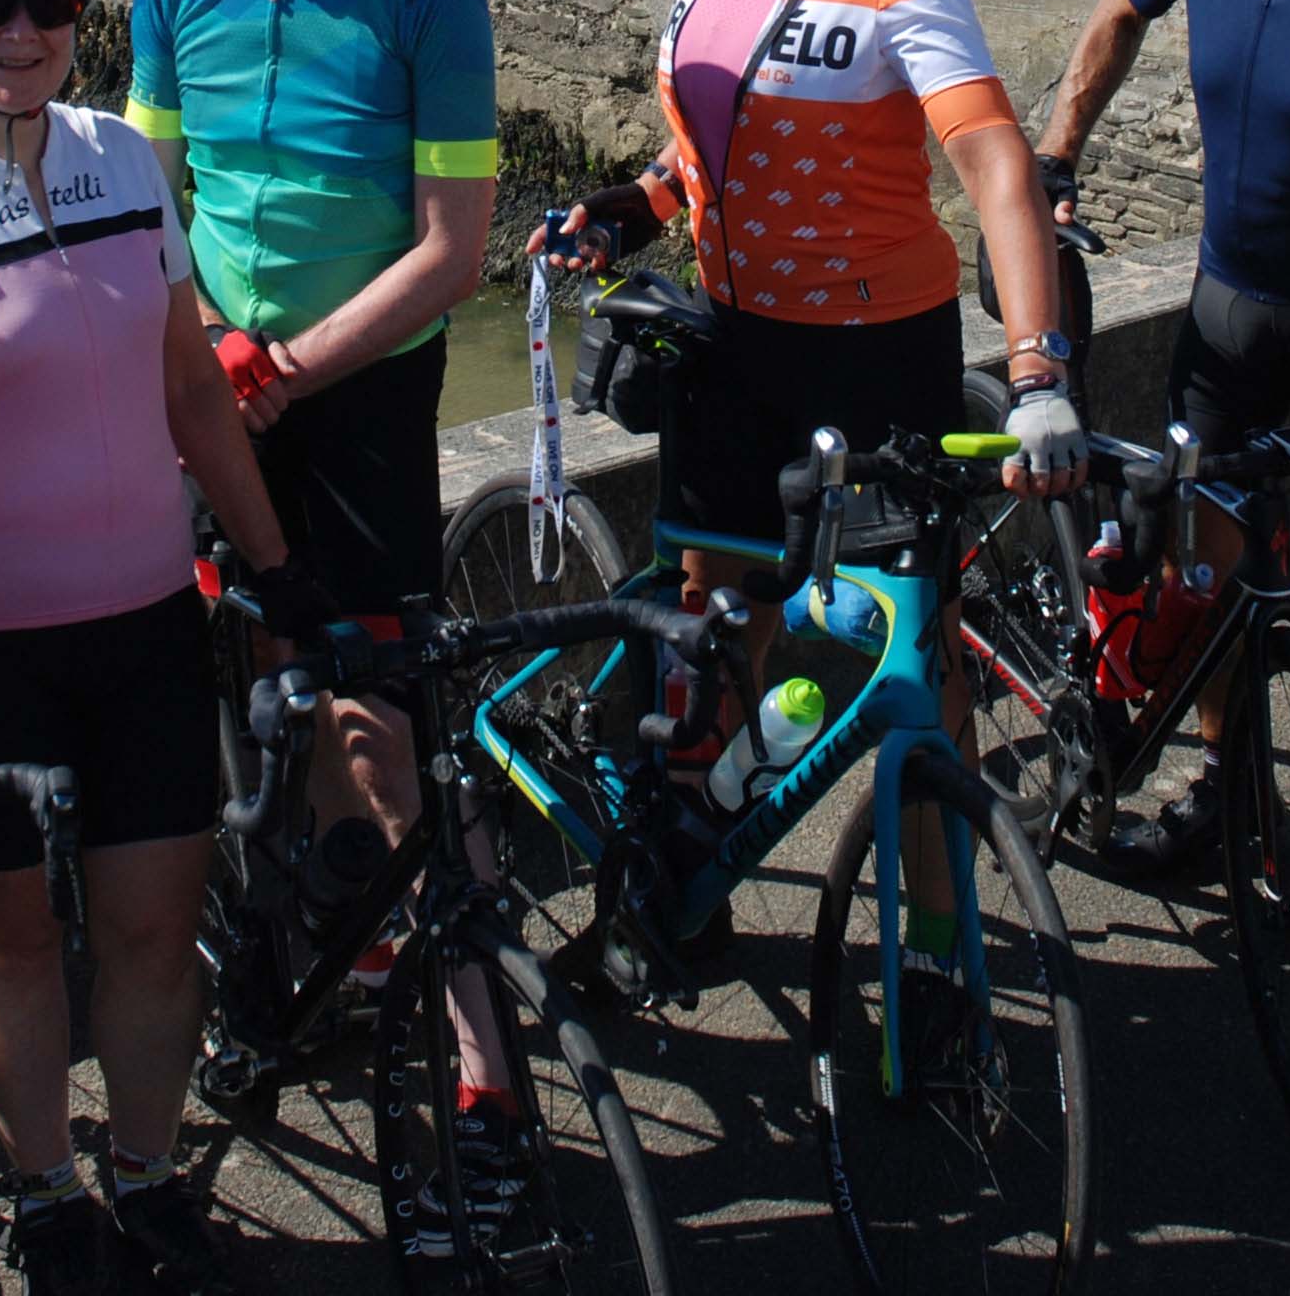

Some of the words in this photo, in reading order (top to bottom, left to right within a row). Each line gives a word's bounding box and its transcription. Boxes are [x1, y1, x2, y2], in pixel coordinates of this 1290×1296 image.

[773, 70, 795, 85] Co.
[549, 440, 557, 460] LIVE
[550, 462, 558, 482] ON
